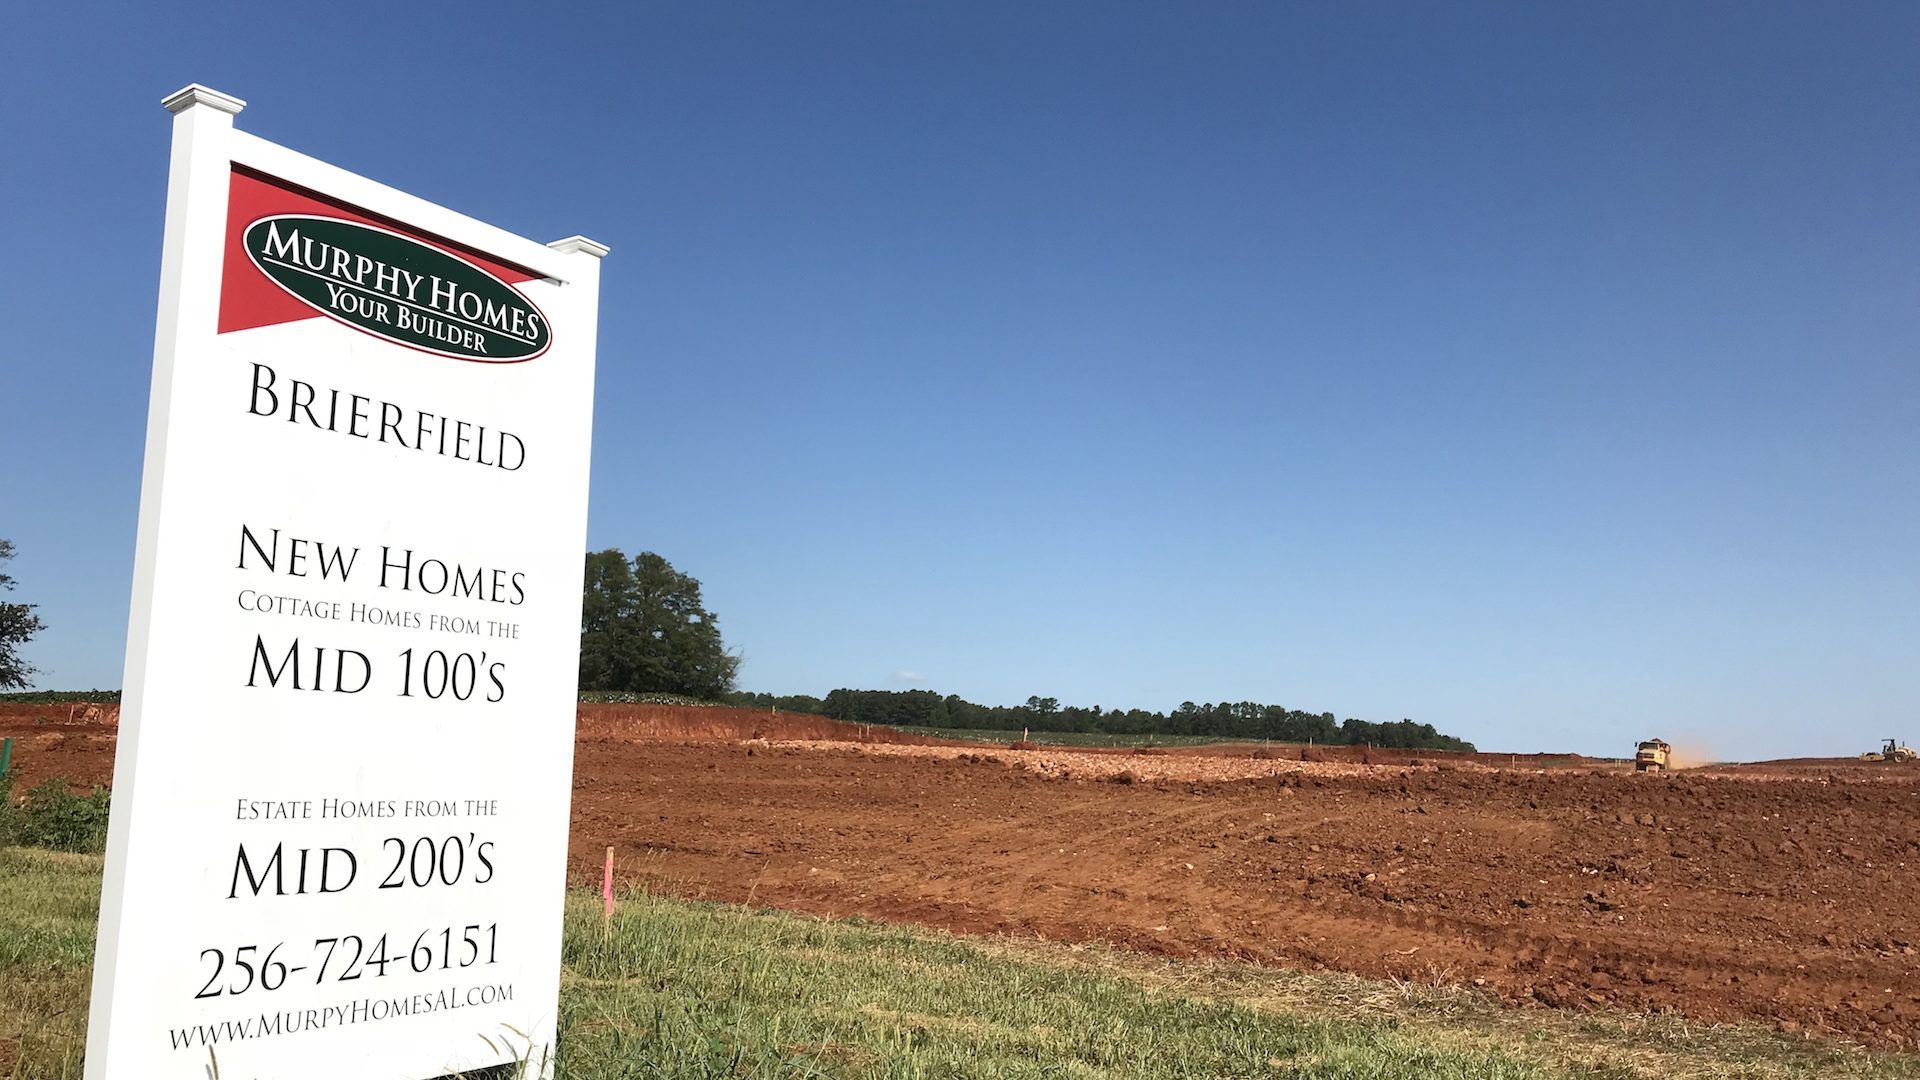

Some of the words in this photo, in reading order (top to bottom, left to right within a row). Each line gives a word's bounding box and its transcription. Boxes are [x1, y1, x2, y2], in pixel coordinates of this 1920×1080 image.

[262, 220, 424, 302] MURPHY
[429, 276, 540, 341] HOMES
[325, 282, 391, 325] YOUR
[397, 305, 488, 354] BUILDER
[246, 361, 526, 471] BRIERFIELD
[235, 524, 361, 583] NEW
[378, 545, 526, 606] HOMES
[237, 589, 341, 620] COTTAGE
[350, 602, 422, 630] HOMES
[429, 614, 481, 635] FROM
[487, 621, 520, 640] THE
[244, 633, 372, 694] MID
[397, 647, 505, 703] 100'S
[236, 798, 312, 820] ESTATE
[321, 798, 396, 819] HOMES
[404, 800, 457, 817] FROM
[464, 799, 498, 816] THE
[225, 841, 358, 900] MID
[378, 832, 494, 889] 200'S
[194, 922, 499, 1000] 256-724-6151
[168, 983, 514, 1051] WWW.MURPYHOMESAL.COM
